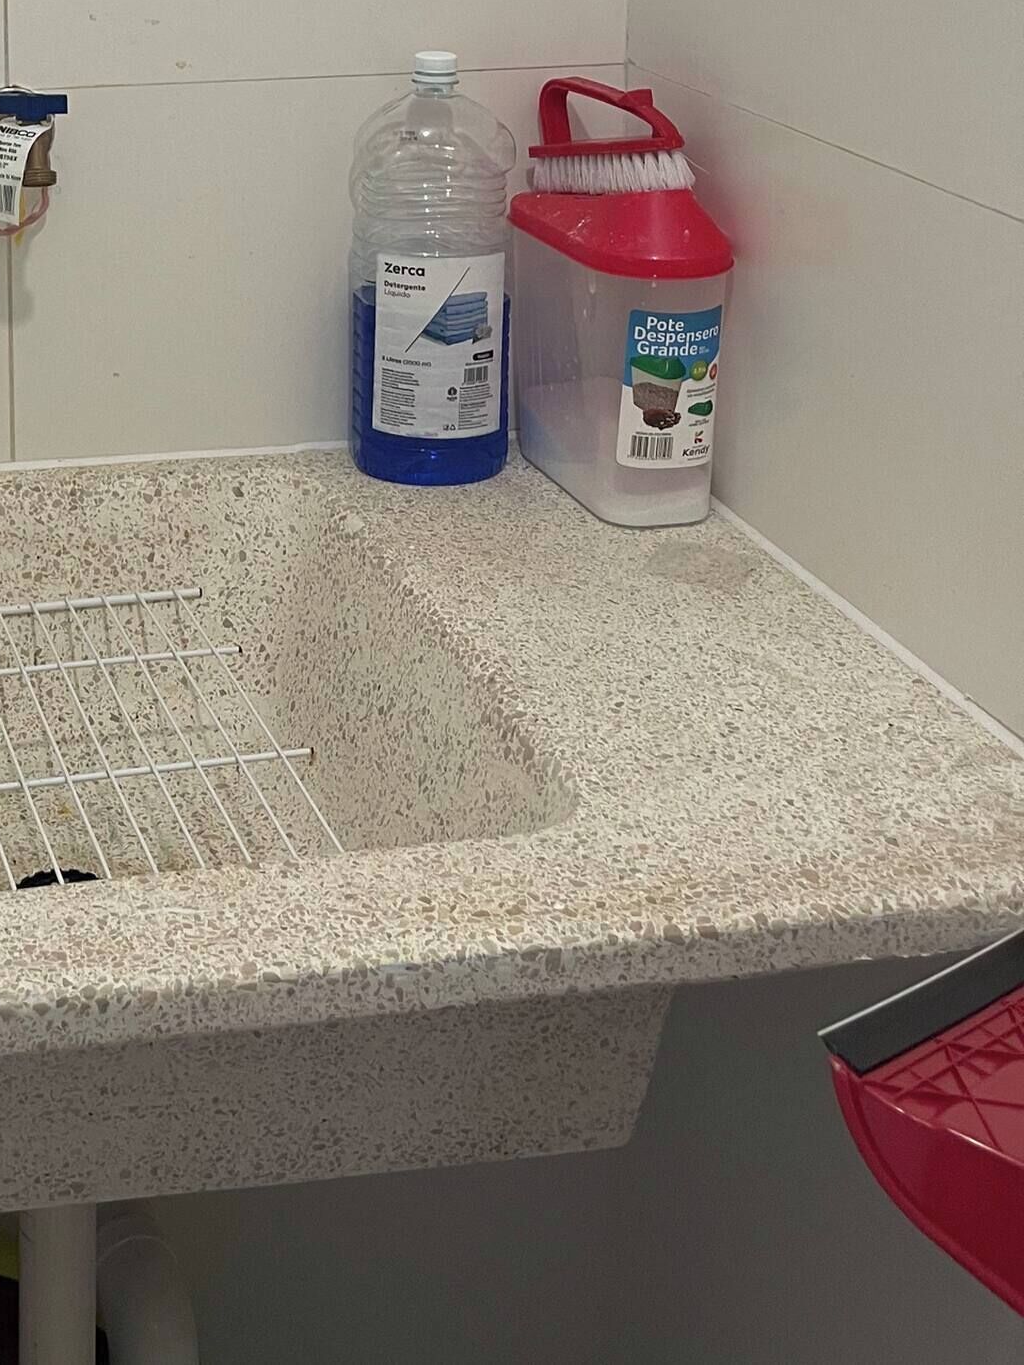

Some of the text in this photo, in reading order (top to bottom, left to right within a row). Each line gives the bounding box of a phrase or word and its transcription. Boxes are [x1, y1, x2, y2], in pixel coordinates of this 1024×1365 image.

[384, 262, 425, 277] Zerca
[384, 280, 426, 292] Detergente
[646, 316, 684, 332] Pote
[634, 325, 719, 344] Despensero
[637, 341, 698, 356] Grande
[682, 444, 710, 458] Kendy
